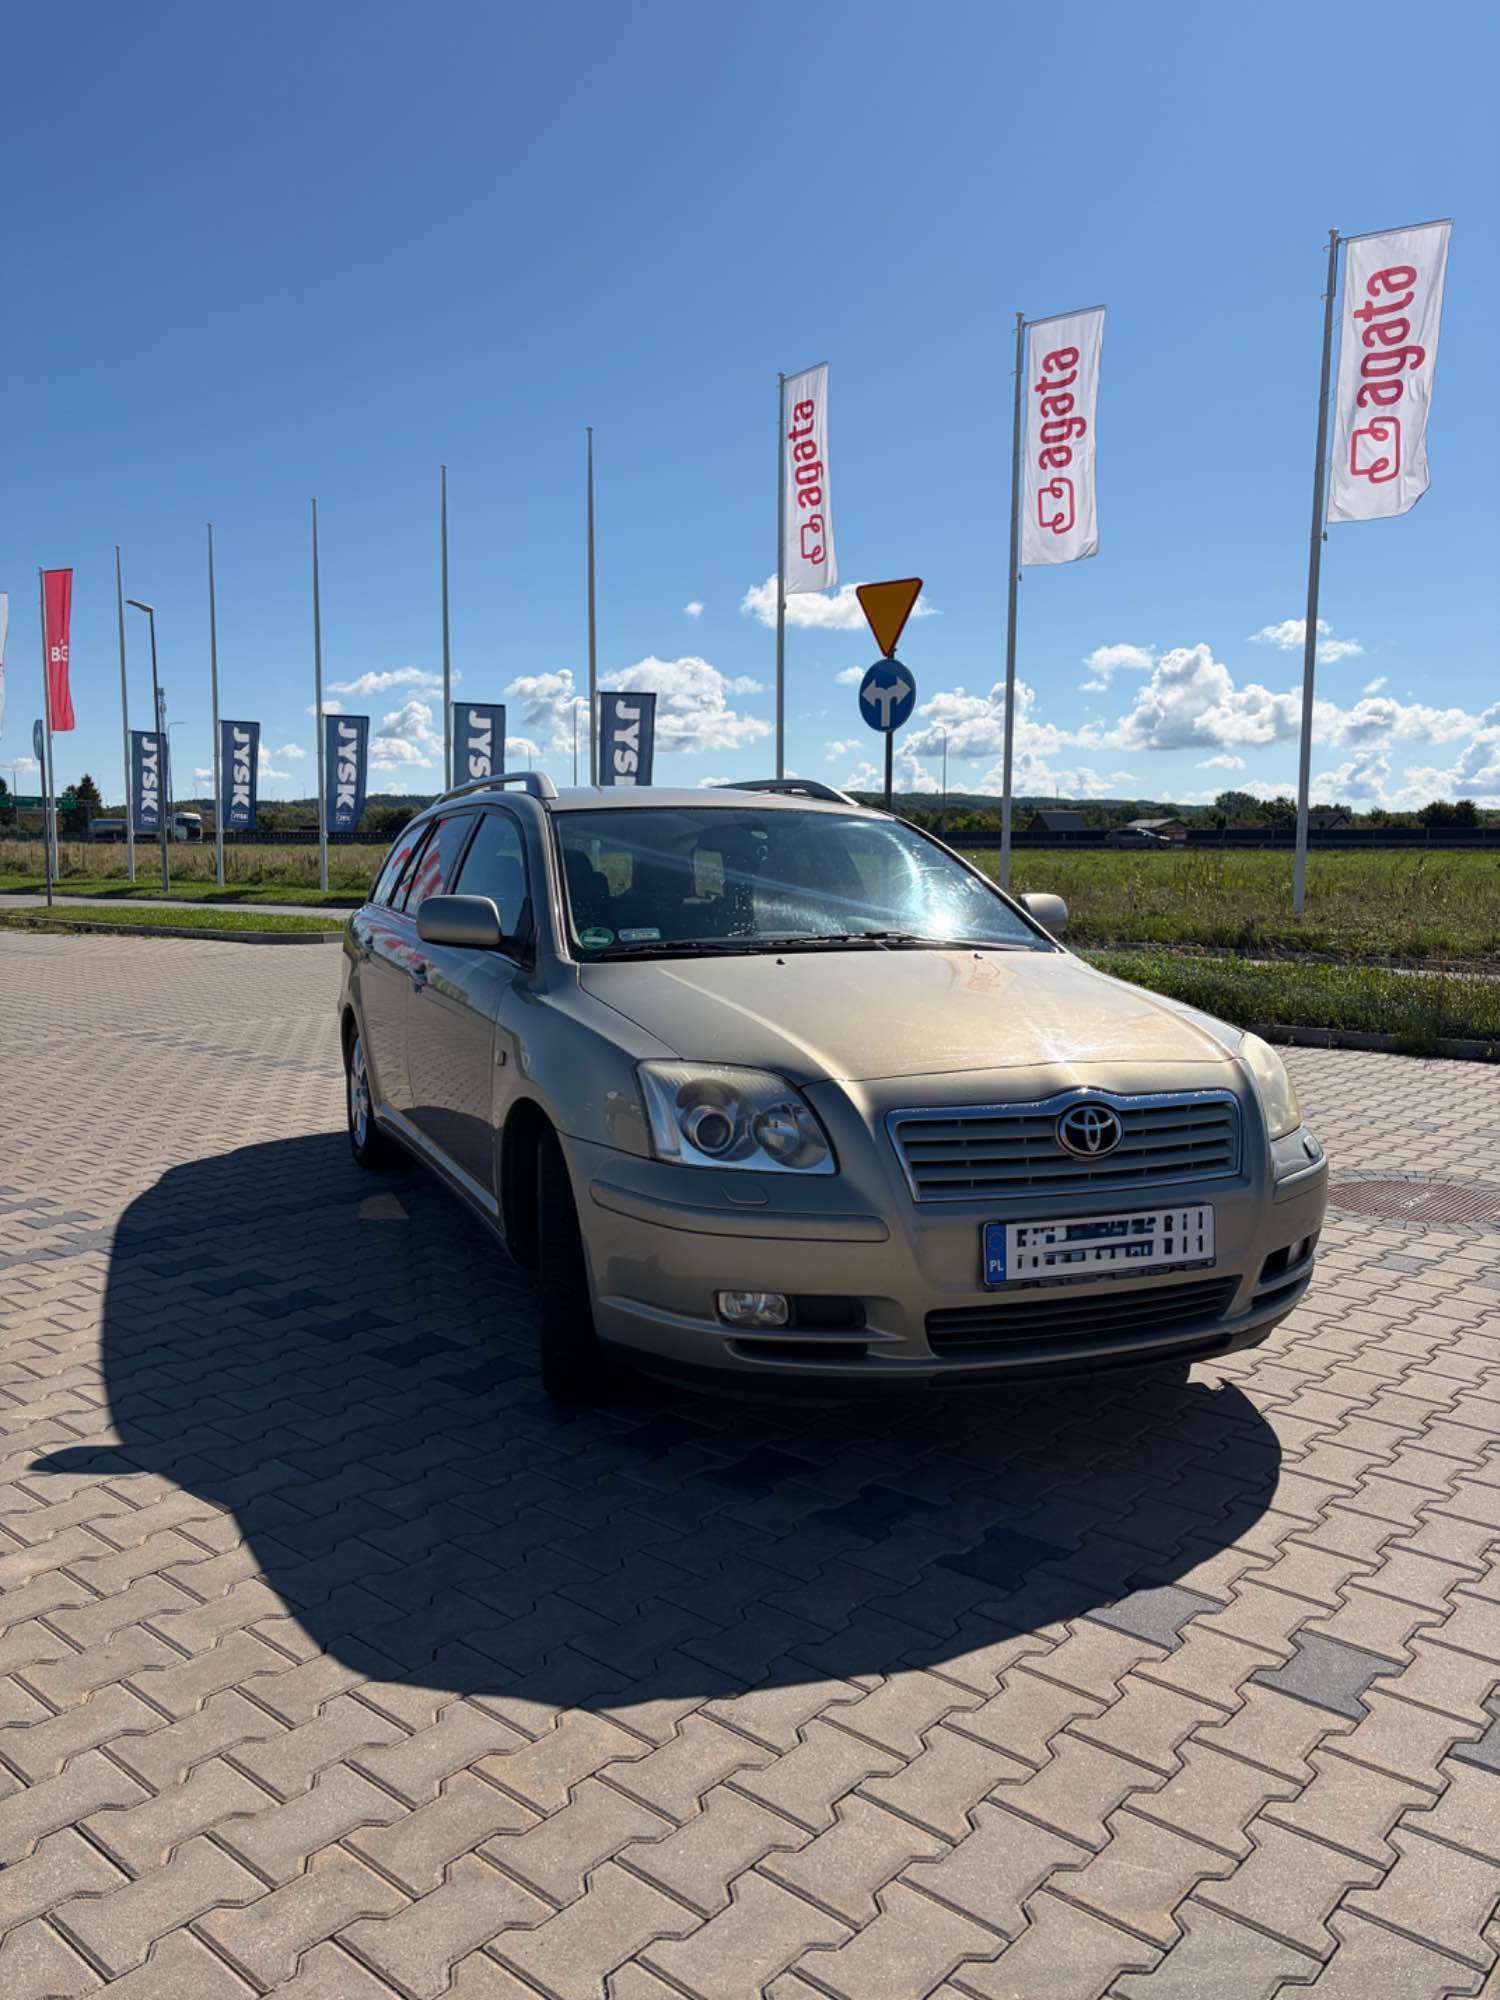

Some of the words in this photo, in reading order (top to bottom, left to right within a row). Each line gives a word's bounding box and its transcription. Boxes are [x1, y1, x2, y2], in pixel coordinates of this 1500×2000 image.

[1353, 265, 1426, 408] agata
[1034, 346, 1087, 470] agata
[788, 398, 824, 509] agata
[141, 736, 158, 812] JYSK
[231, 726, 250, 808] JYSK
[336, 720, 358, 810] JYSK
[468, 709, 492, 788] JYS
[988, 1259, 1004, 1272] PL
